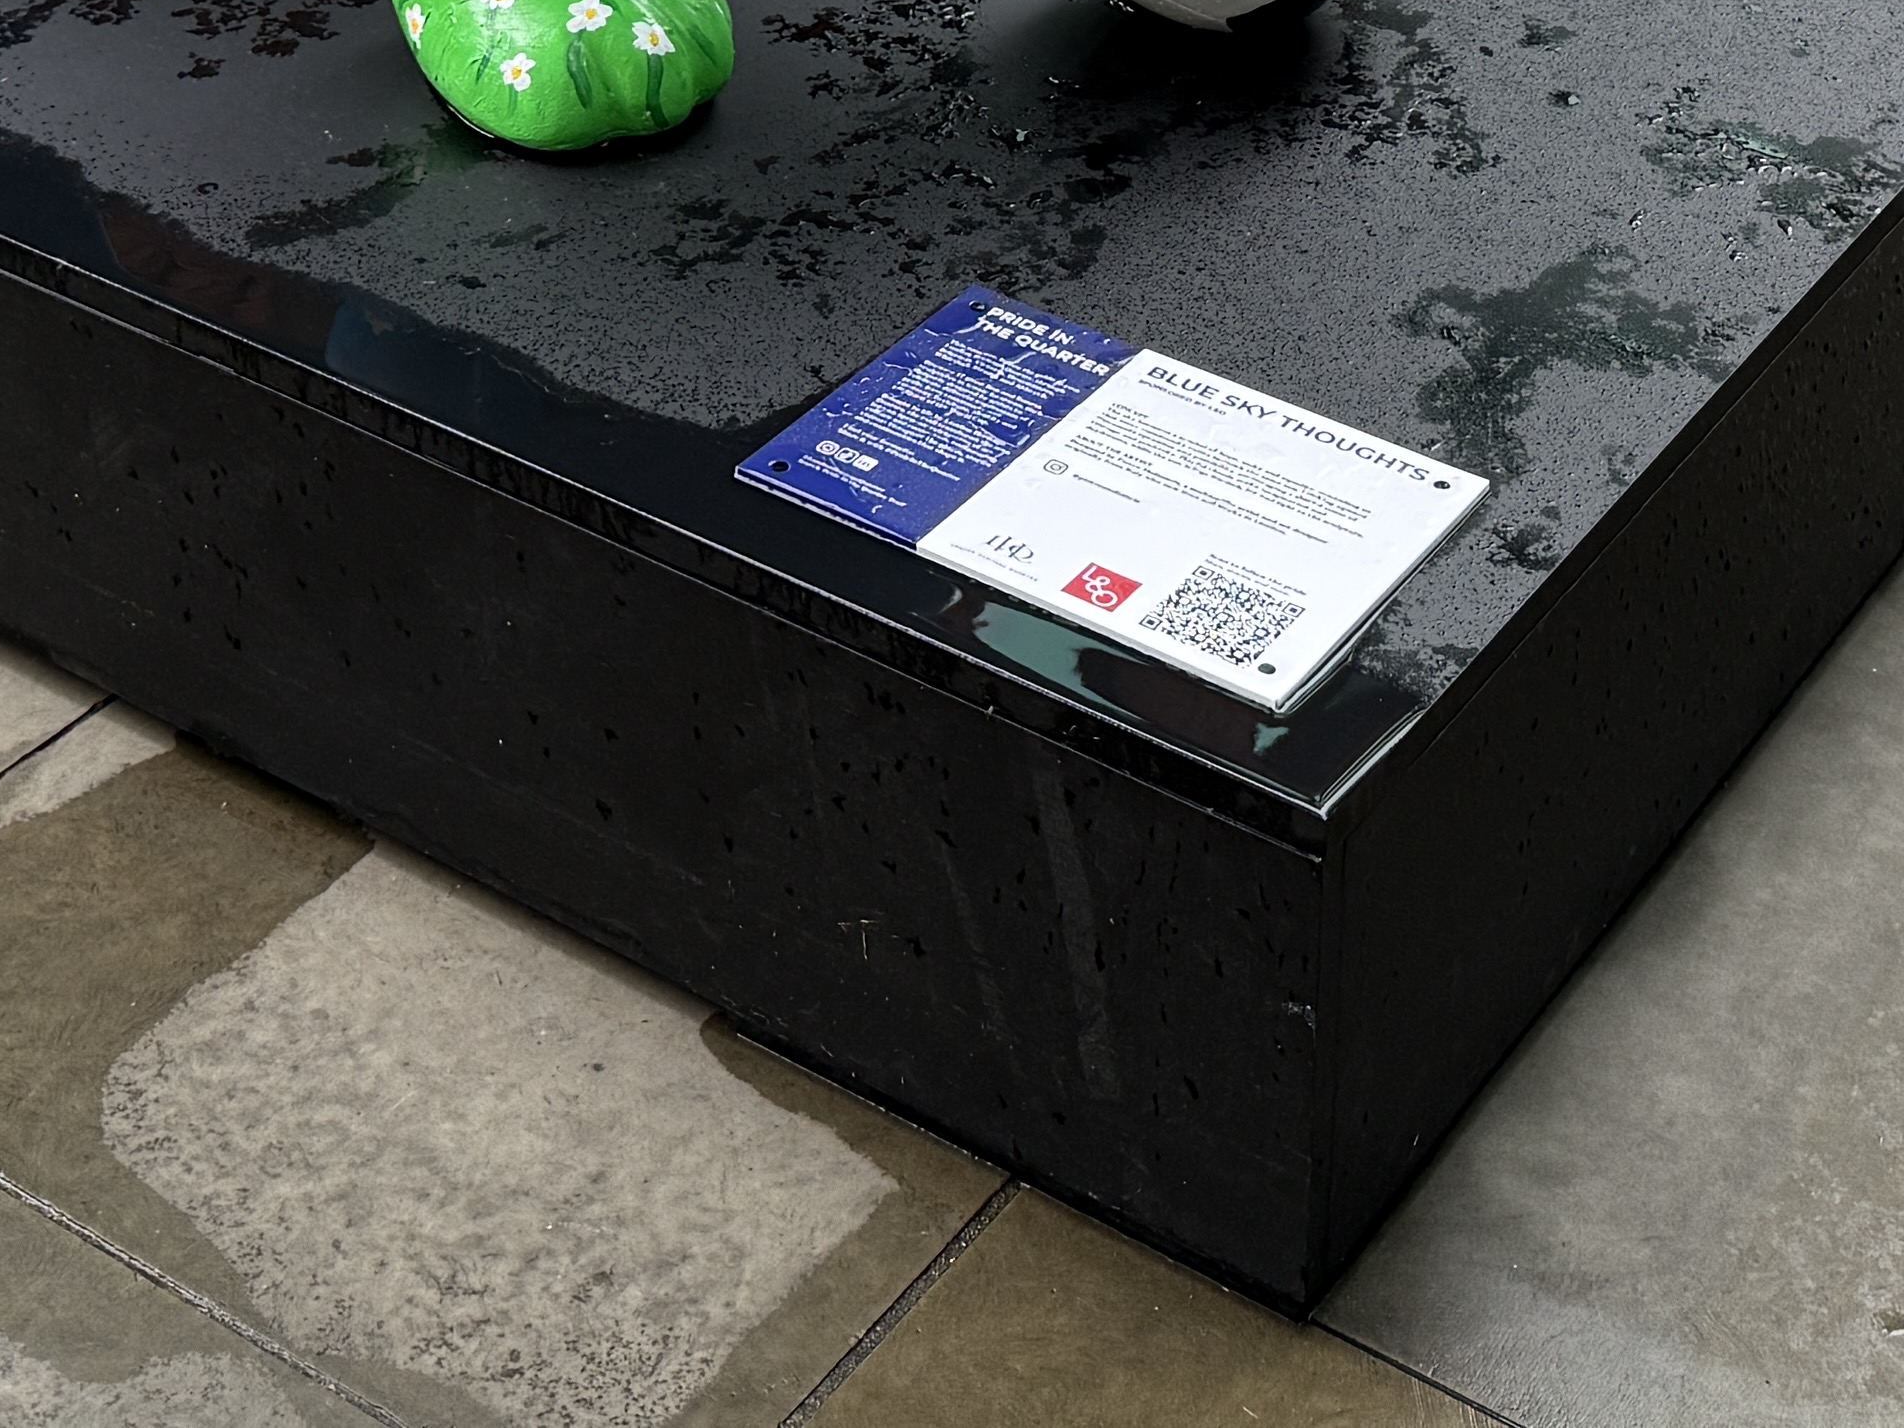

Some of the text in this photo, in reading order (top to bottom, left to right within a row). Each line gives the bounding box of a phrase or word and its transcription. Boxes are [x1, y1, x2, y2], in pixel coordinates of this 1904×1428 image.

[979, 317, 1016, 341] THE
[1014, 334, 1111, 377] QUARTER
[987, 307, 1073, 345] PRIDE IN
[1145, 365, 1432, 482] BLUE SKY THOUGHTS
[1081, 565, 1118, 608] L&O
